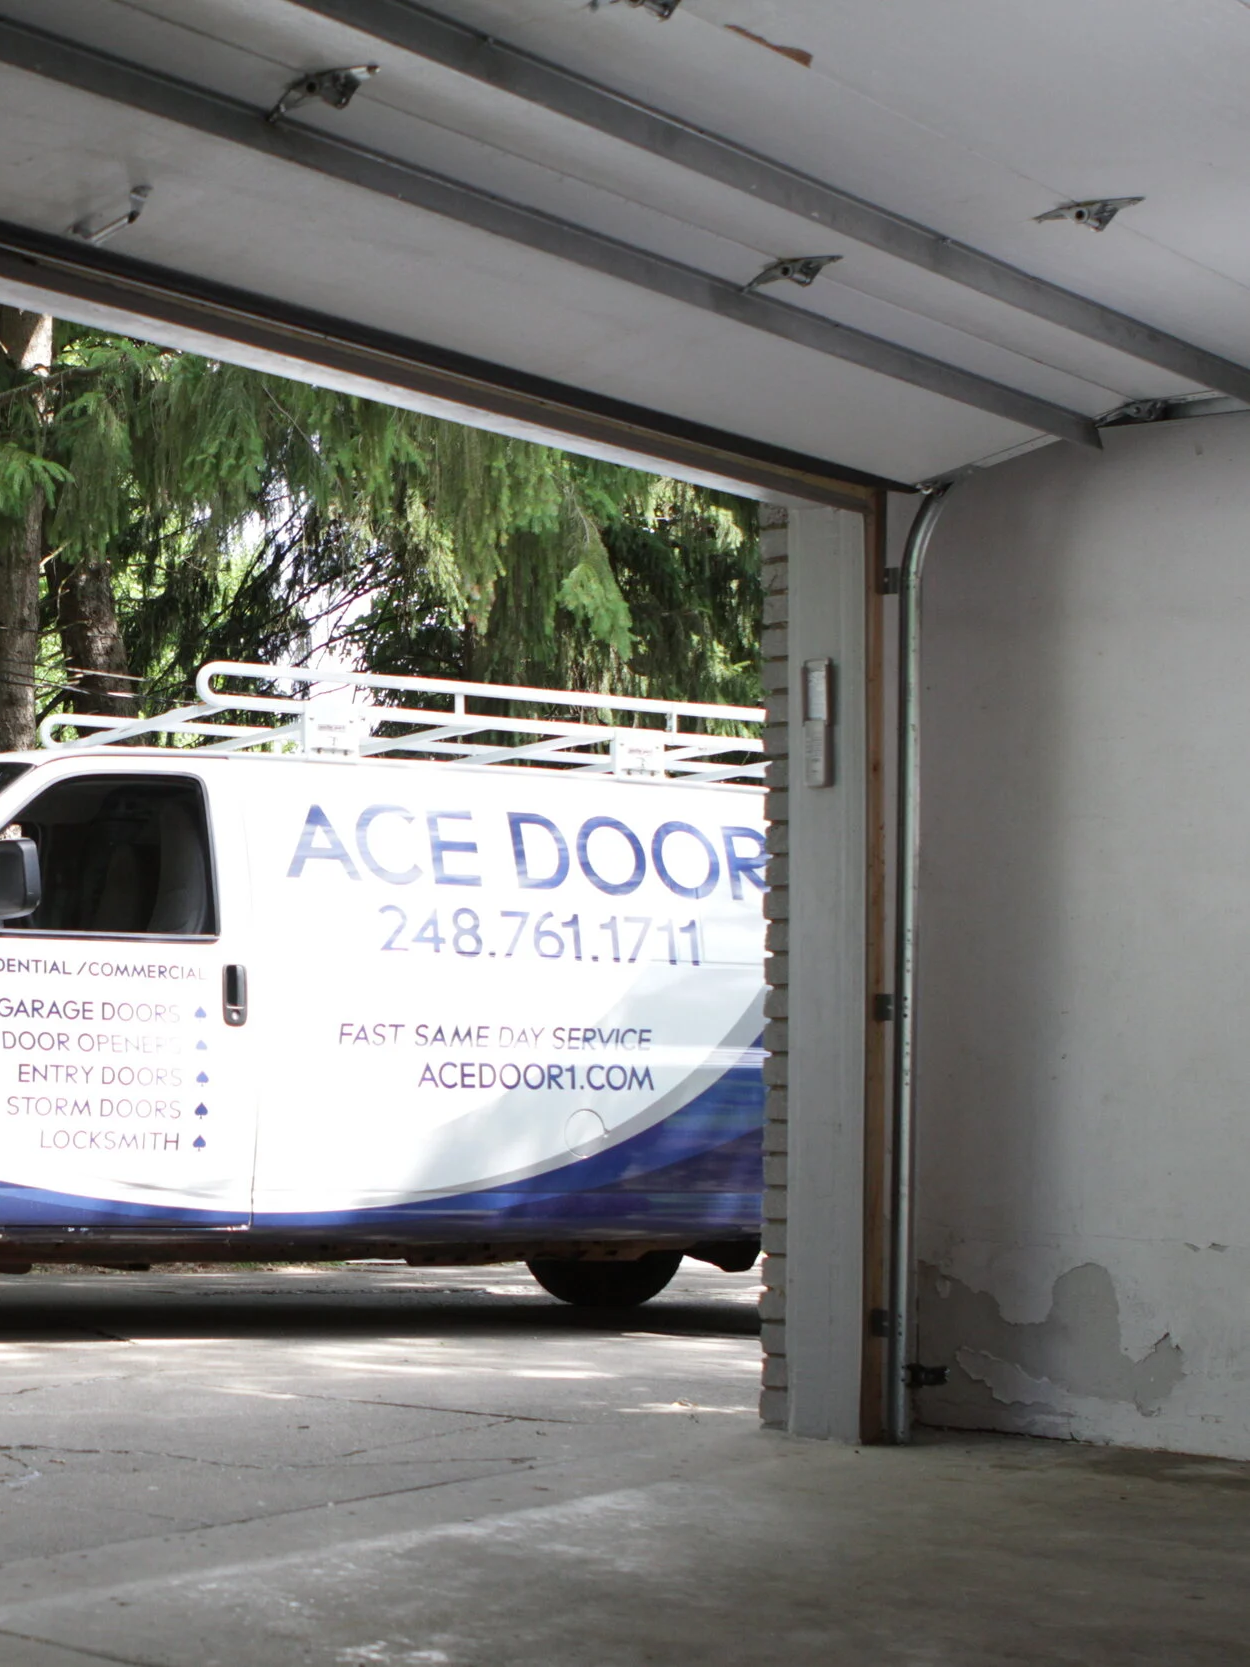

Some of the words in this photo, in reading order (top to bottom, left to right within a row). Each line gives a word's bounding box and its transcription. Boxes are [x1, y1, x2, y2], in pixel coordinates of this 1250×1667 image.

[286, 804, 482, 886] ACE
[506, 811, 769, 900] DOOR
[378, 905, 701, 966] 248.761.1711
[101, 1002, 181, 1023] DOORS
[2, 1031, 70, 1051] DOOR
[339, 1023, 405, 1045] FAST
[414, 1024, 490, 1048] SAME
[498, 1026, 545, 1049] DAY
[552, 1027, 652, 1051] SERVICE
[18, 1064, 94, 1084] ENTRY
[101, 1066, 182, 1087] DOORS
[418, 1062, 654, 1091] ACEDOOR1.COM
[7, 1096, 91, 1117] STORM
[100, 1099, 181, 1119] DOORS
[40, 1130, 179, 1151] LOCKSMITH
